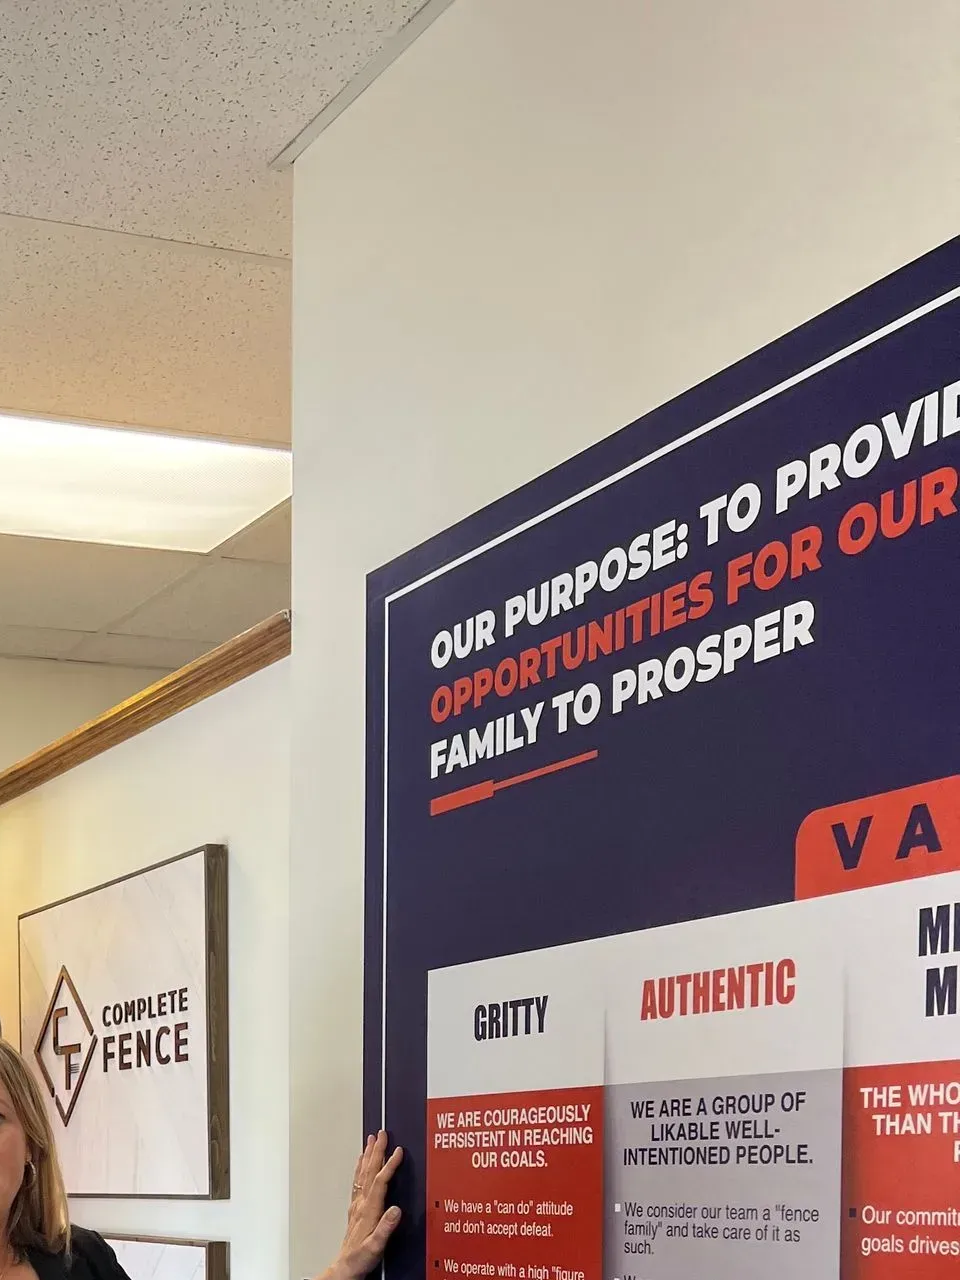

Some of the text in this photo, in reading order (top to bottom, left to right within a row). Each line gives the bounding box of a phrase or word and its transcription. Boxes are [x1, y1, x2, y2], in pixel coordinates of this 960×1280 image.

[432, 610, 495, 669] OUR
[505, 520, 689, 637] PURPOSE:
[700, 483, 760, 546] TO
[432, 466, 957, 723] OPPORTUNITIES FOR OUR
[432, 600, 815, 778] FAMILY TO PROSPER
[641, 958, 796, 1020] AUTHENTIC
[102, 987, 188, 1027] COMPLETE
[474, 995, 548, 1041] GRITTY
[103, 1022, 188, 1072] FENCE
[631, 1092, 806, 1118] WE ARE A GROUP OF
[860, 1086, 901, 1108] THE
[437, 1104, 590, 1128] WE ARE COURAGEOUSLY
[872, 1112, 932, 1135] THAN
[435, 1127, 593, 1149] PERSISTENT IN REACHING
[651, 1120, 780, 1141] LIKABLE WELL-
[472, 1150, 548, 1168] OUR GOALS.
[624, 1144, 813, 1166] INTENTIONED PEOPLE.
[444, 1200, 573, 1215] We have a "can do" attitude
[625, 1202, 819, 1222] We consider our team a "fence
[862, 1205, 891, 1224] Our
[444, 1220, 553, 1238] and don't accept defeat.
[625, 1221, 800, 1242] family" and take care of it as
[624, 1240, 654, 1254] such.
[861, 1234, 960, 1256] goals drives
[444, 1259, 458, 1272] We
[461, 1262, 495, 1277] operate
[498, 1264, 516, 1277] with
[519, 1268, 525, 1278] a
